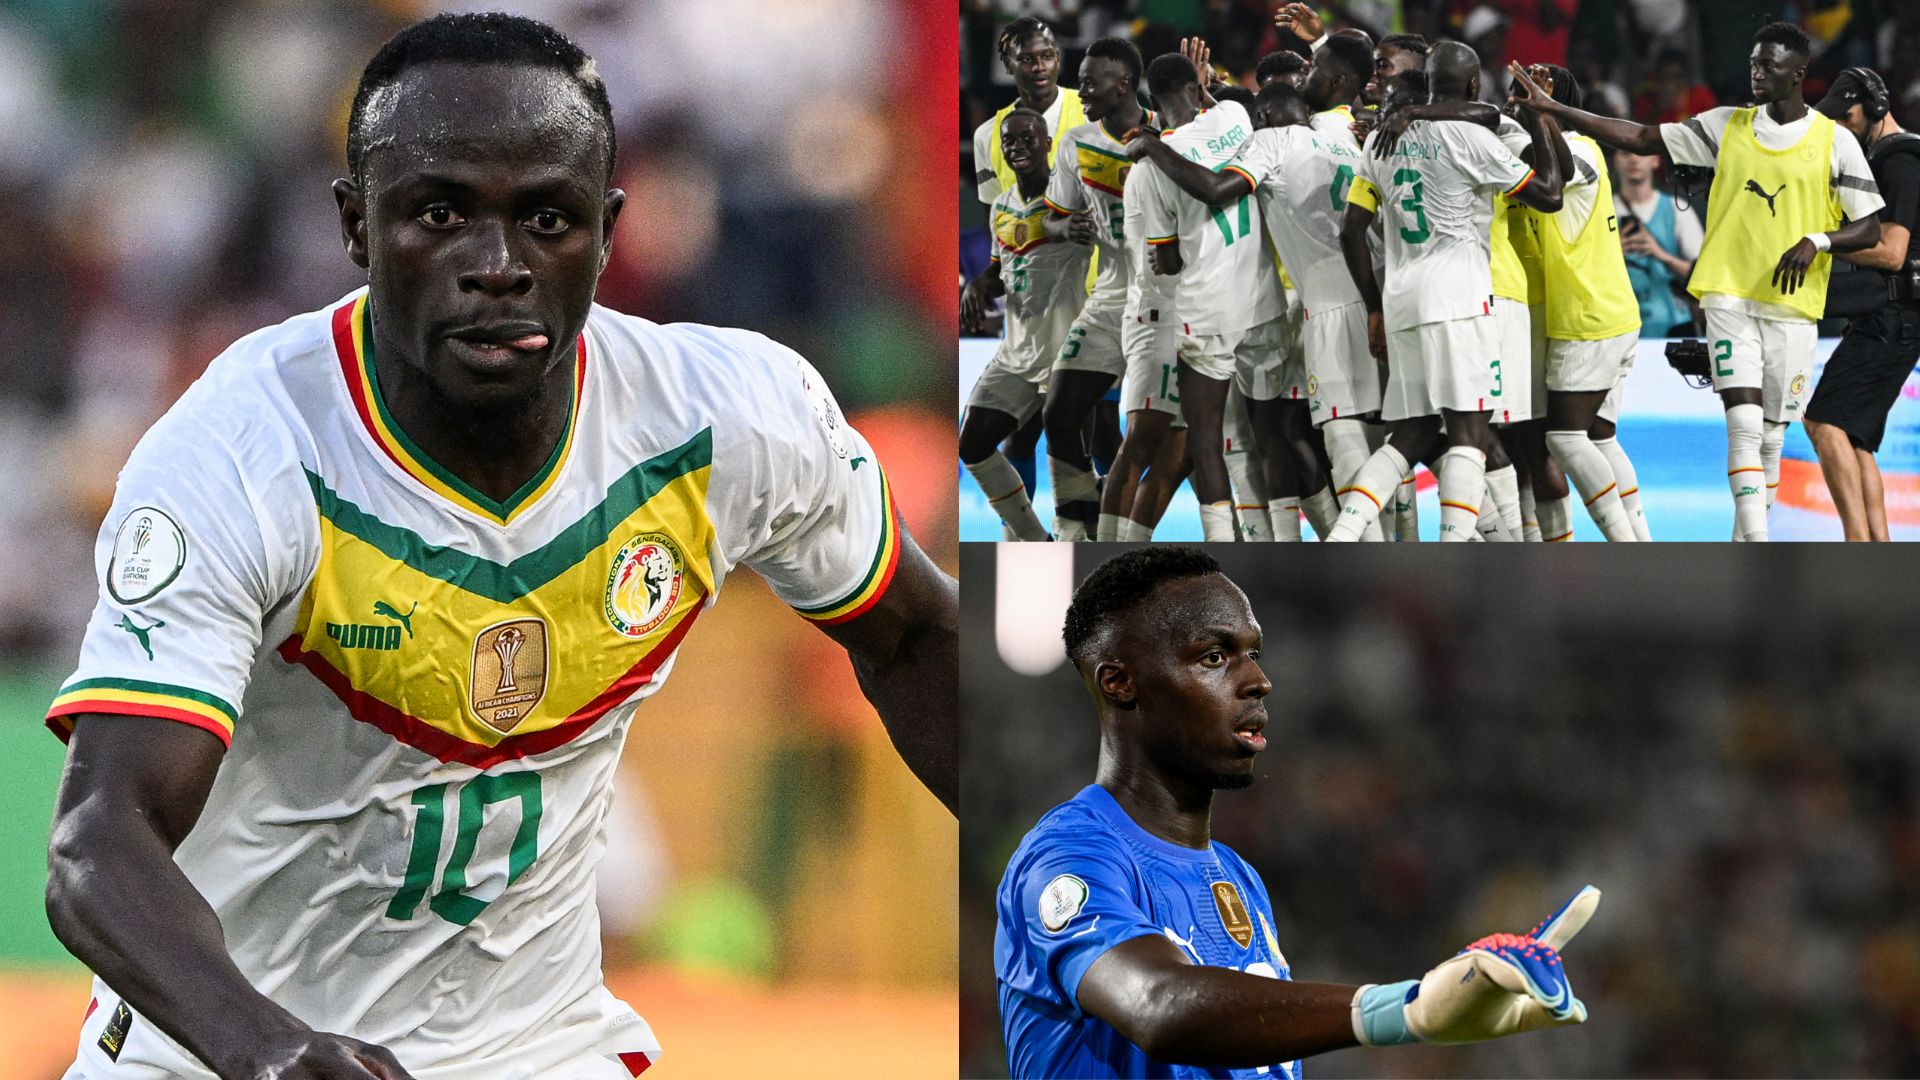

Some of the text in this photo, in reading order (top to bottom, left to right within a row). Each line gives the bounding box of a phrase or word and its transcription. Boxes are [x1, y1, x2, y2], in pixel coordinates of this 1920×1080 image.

[1207, 124, 1248, 154] SARR
[1393, 168, 1430, 244] 3
[1715, 339, 1734, 377] 2
[1490, 359, 1502, 397] 3
[326, 622, 402, 650] PUMA
[478, 692, 537, 709] AFRICAN CHAMPIONS
[495, 707, 518, 720] 2021
[385, 770, 544, 927] 10
